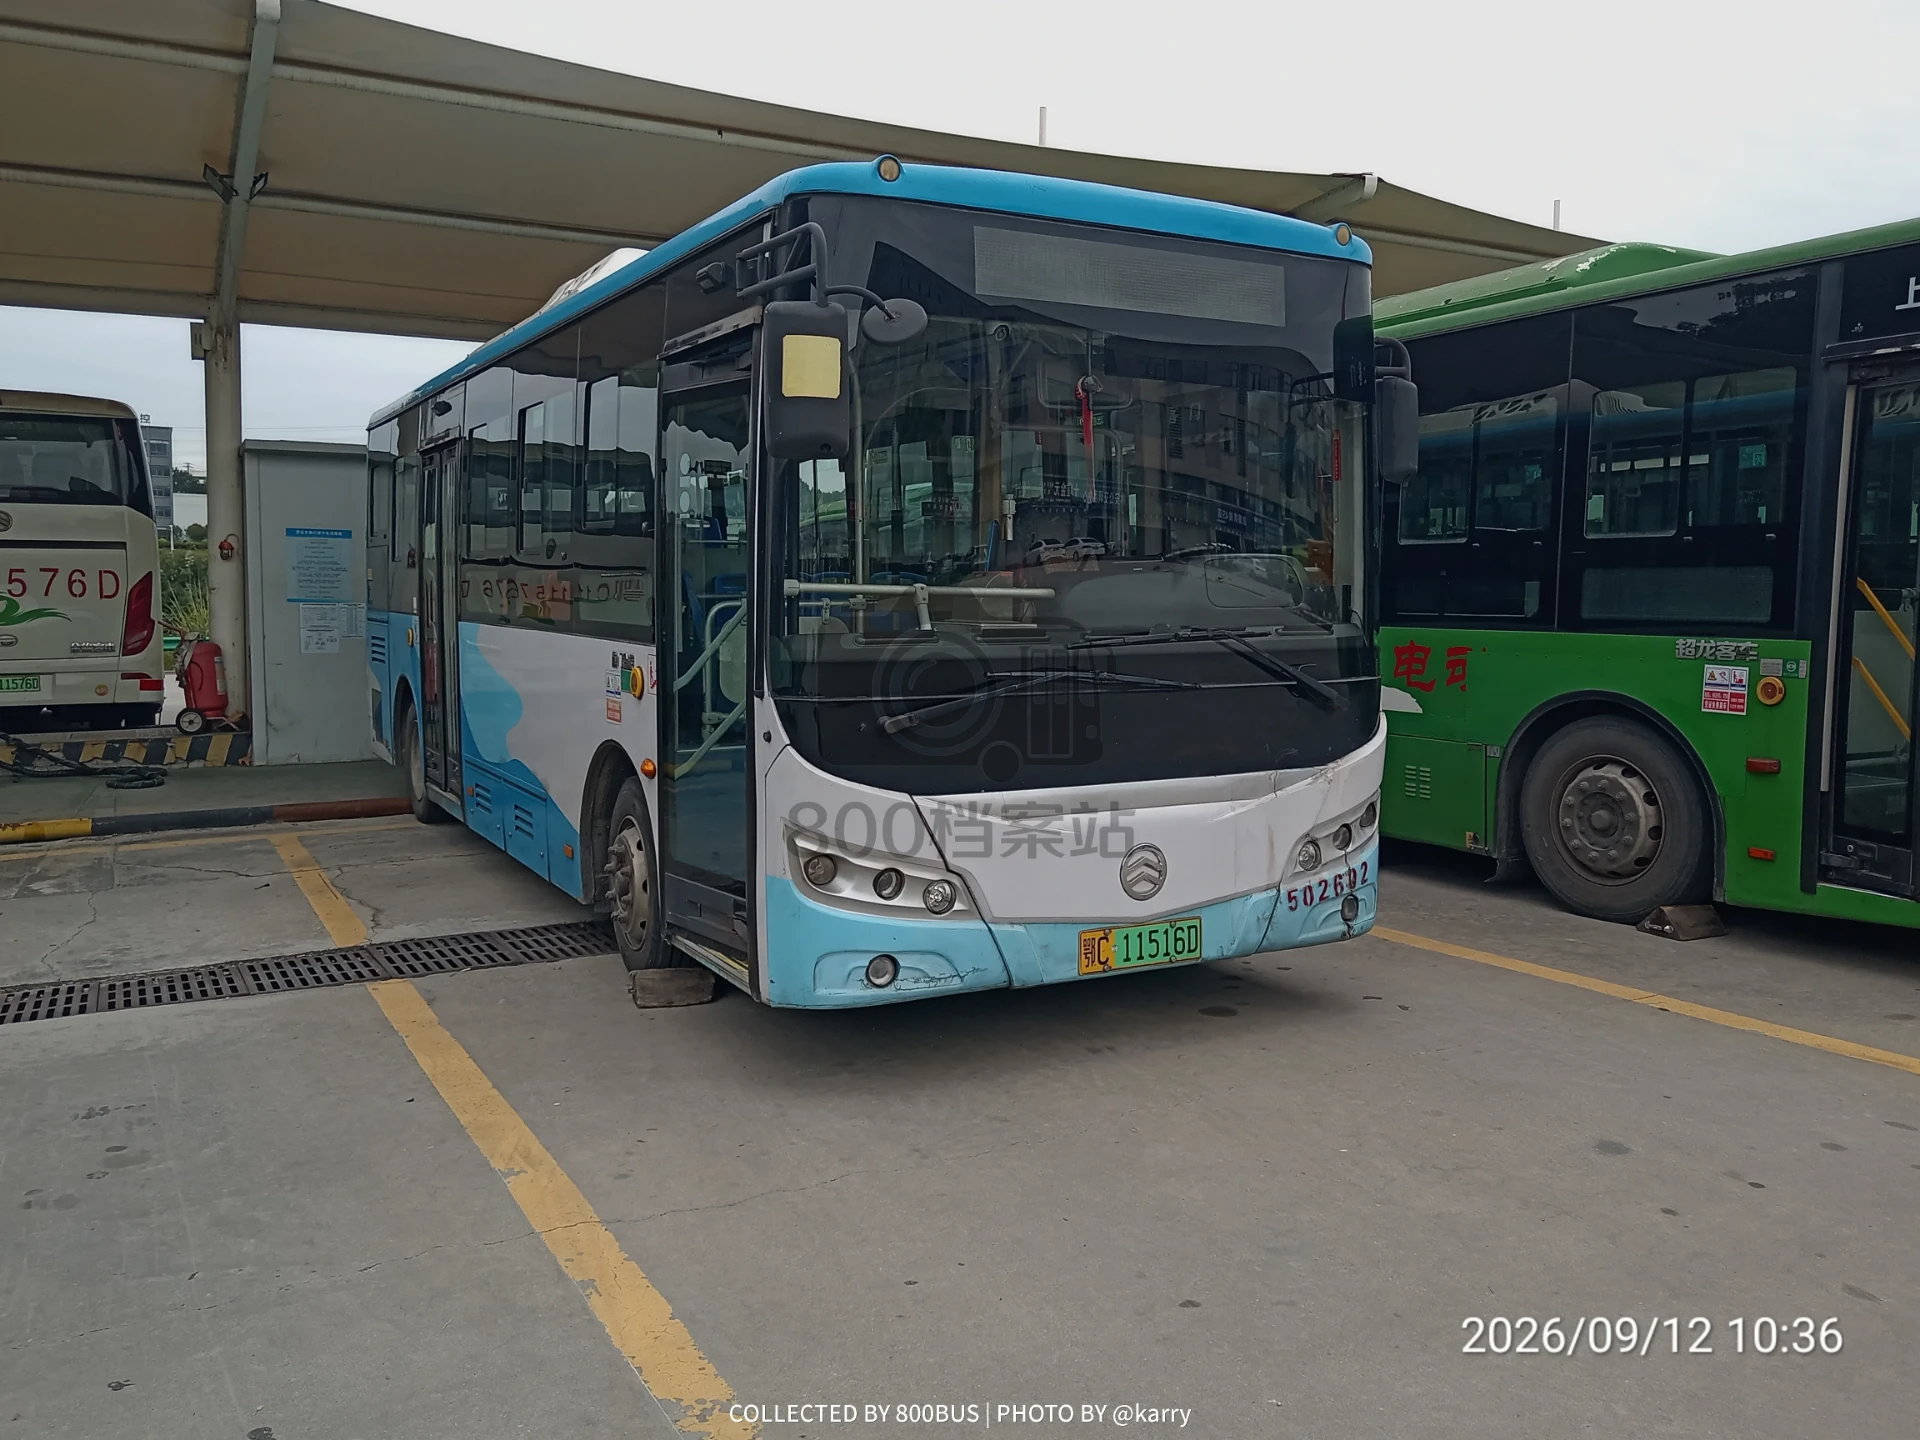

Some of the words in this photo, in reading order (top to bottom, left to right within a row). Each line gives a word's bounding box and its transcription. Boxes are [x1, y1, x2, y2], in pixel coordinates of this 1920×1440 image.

[7, 567, 120, 600] 576D
[1675, 638, 1759, 662] 超龙客车
[1287, 861, 1368, 912] 502602
[1122, 924, 1199, 963] 11516D
